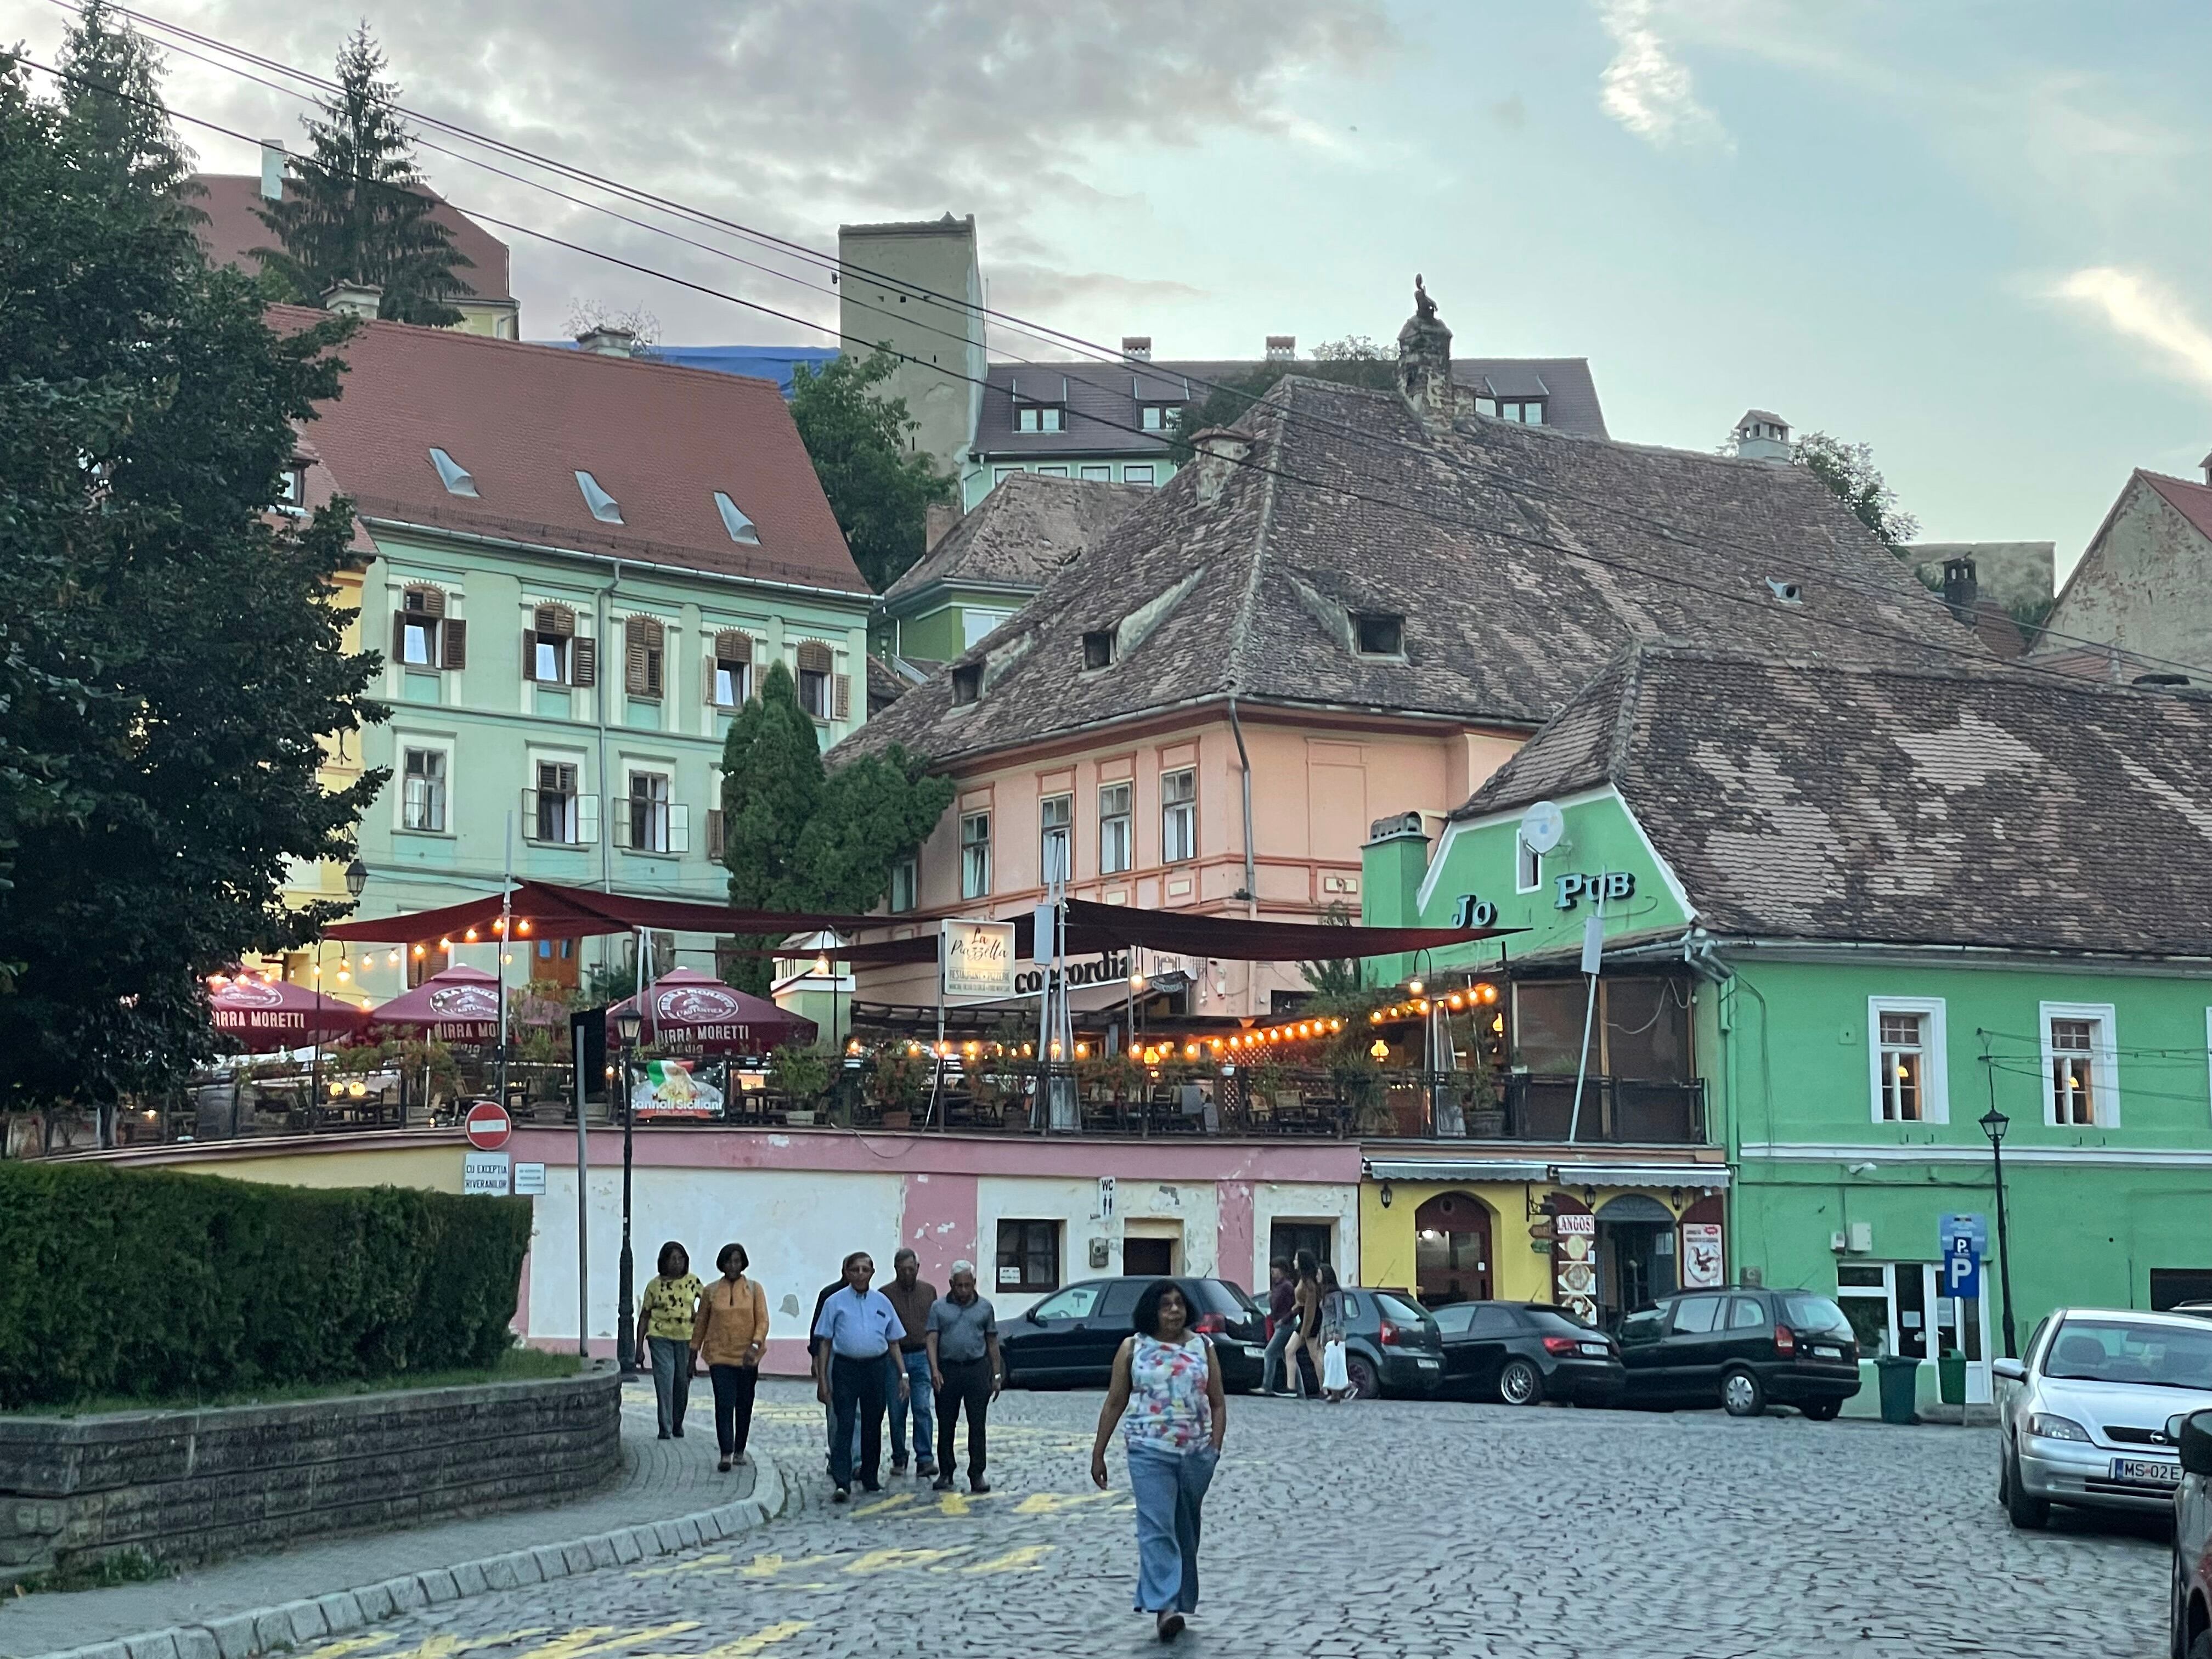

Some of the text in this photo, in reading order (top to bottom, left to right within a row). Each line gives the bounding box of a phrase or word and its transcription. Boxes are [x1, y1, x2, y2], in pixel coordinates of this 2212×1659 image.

[972, 927, 988, 944] La
[211, 1011, 304, 1028] IRRA MORETTI
[697, 1025, 749, 1040] MORETTI
[466, 1165, 475, 1173] CU
[466, 1180, 507, 1188] RIVERANILOR
[1102, 1179, 1113, 1191] WC
[1957, 1239, 1967, 1253] P
[1951, 1258, 1972, 1289] P
[2125, 1463, 2145, 1477] MS
[2151, 1465, 2168, 1479] 02
